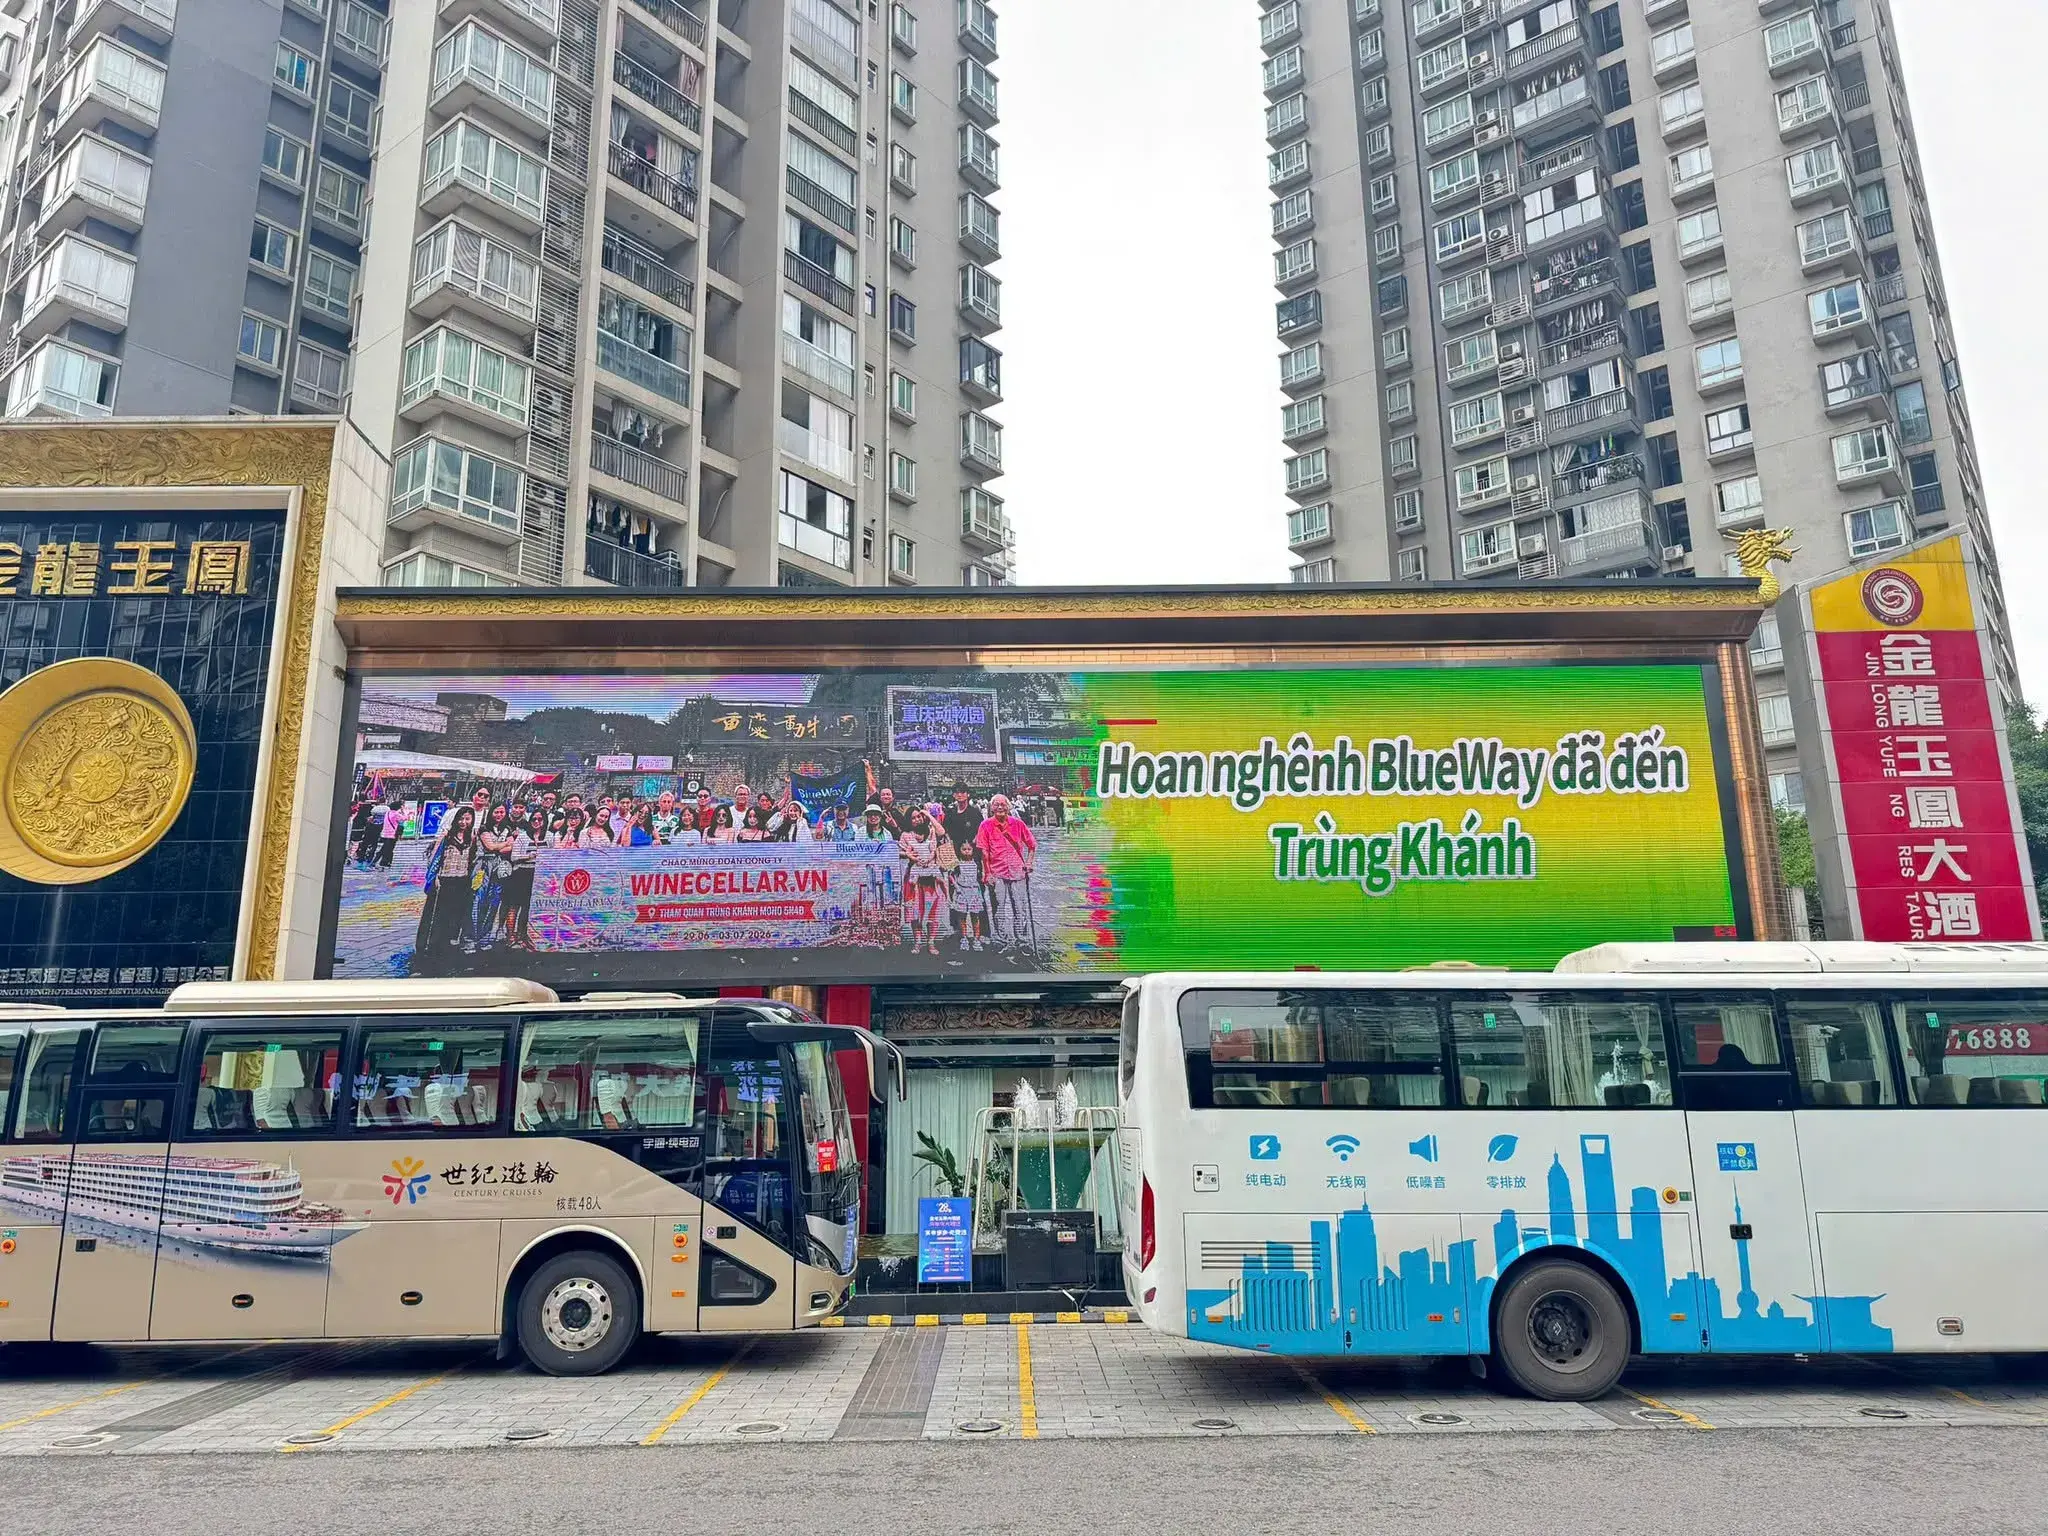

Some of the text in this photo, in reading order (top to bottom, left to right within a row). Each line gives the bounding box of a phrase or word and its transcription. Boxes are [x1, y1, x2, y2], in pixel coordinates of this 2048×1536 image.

[1865, 652, 1881, 676] JIN
[1871, 684, 1889, 728] LONG
[902, 704, 985, 724] 重庆动物园
[1100, 729, 1685, 807] Hoan nghênh BlueWay đã đến
[836, 843, 874, 853] BlueWay
[1273, 814, 1532, 892] Trùng Khánh
[630, 870, 828, 896] WINECELLAR.VN
[1245, 1173, 1287, 1187] 纯电动
[1326, 1175, 1367, 1189] 无线网
[1406, 1175, 1446, 1189] 低噪音
[1486, 1175, 1528, 1189] 零排放
[453, 1188, 543, 1198] CENTURY CRUISES
[556, 1196, 602, 1211] 核载48人
